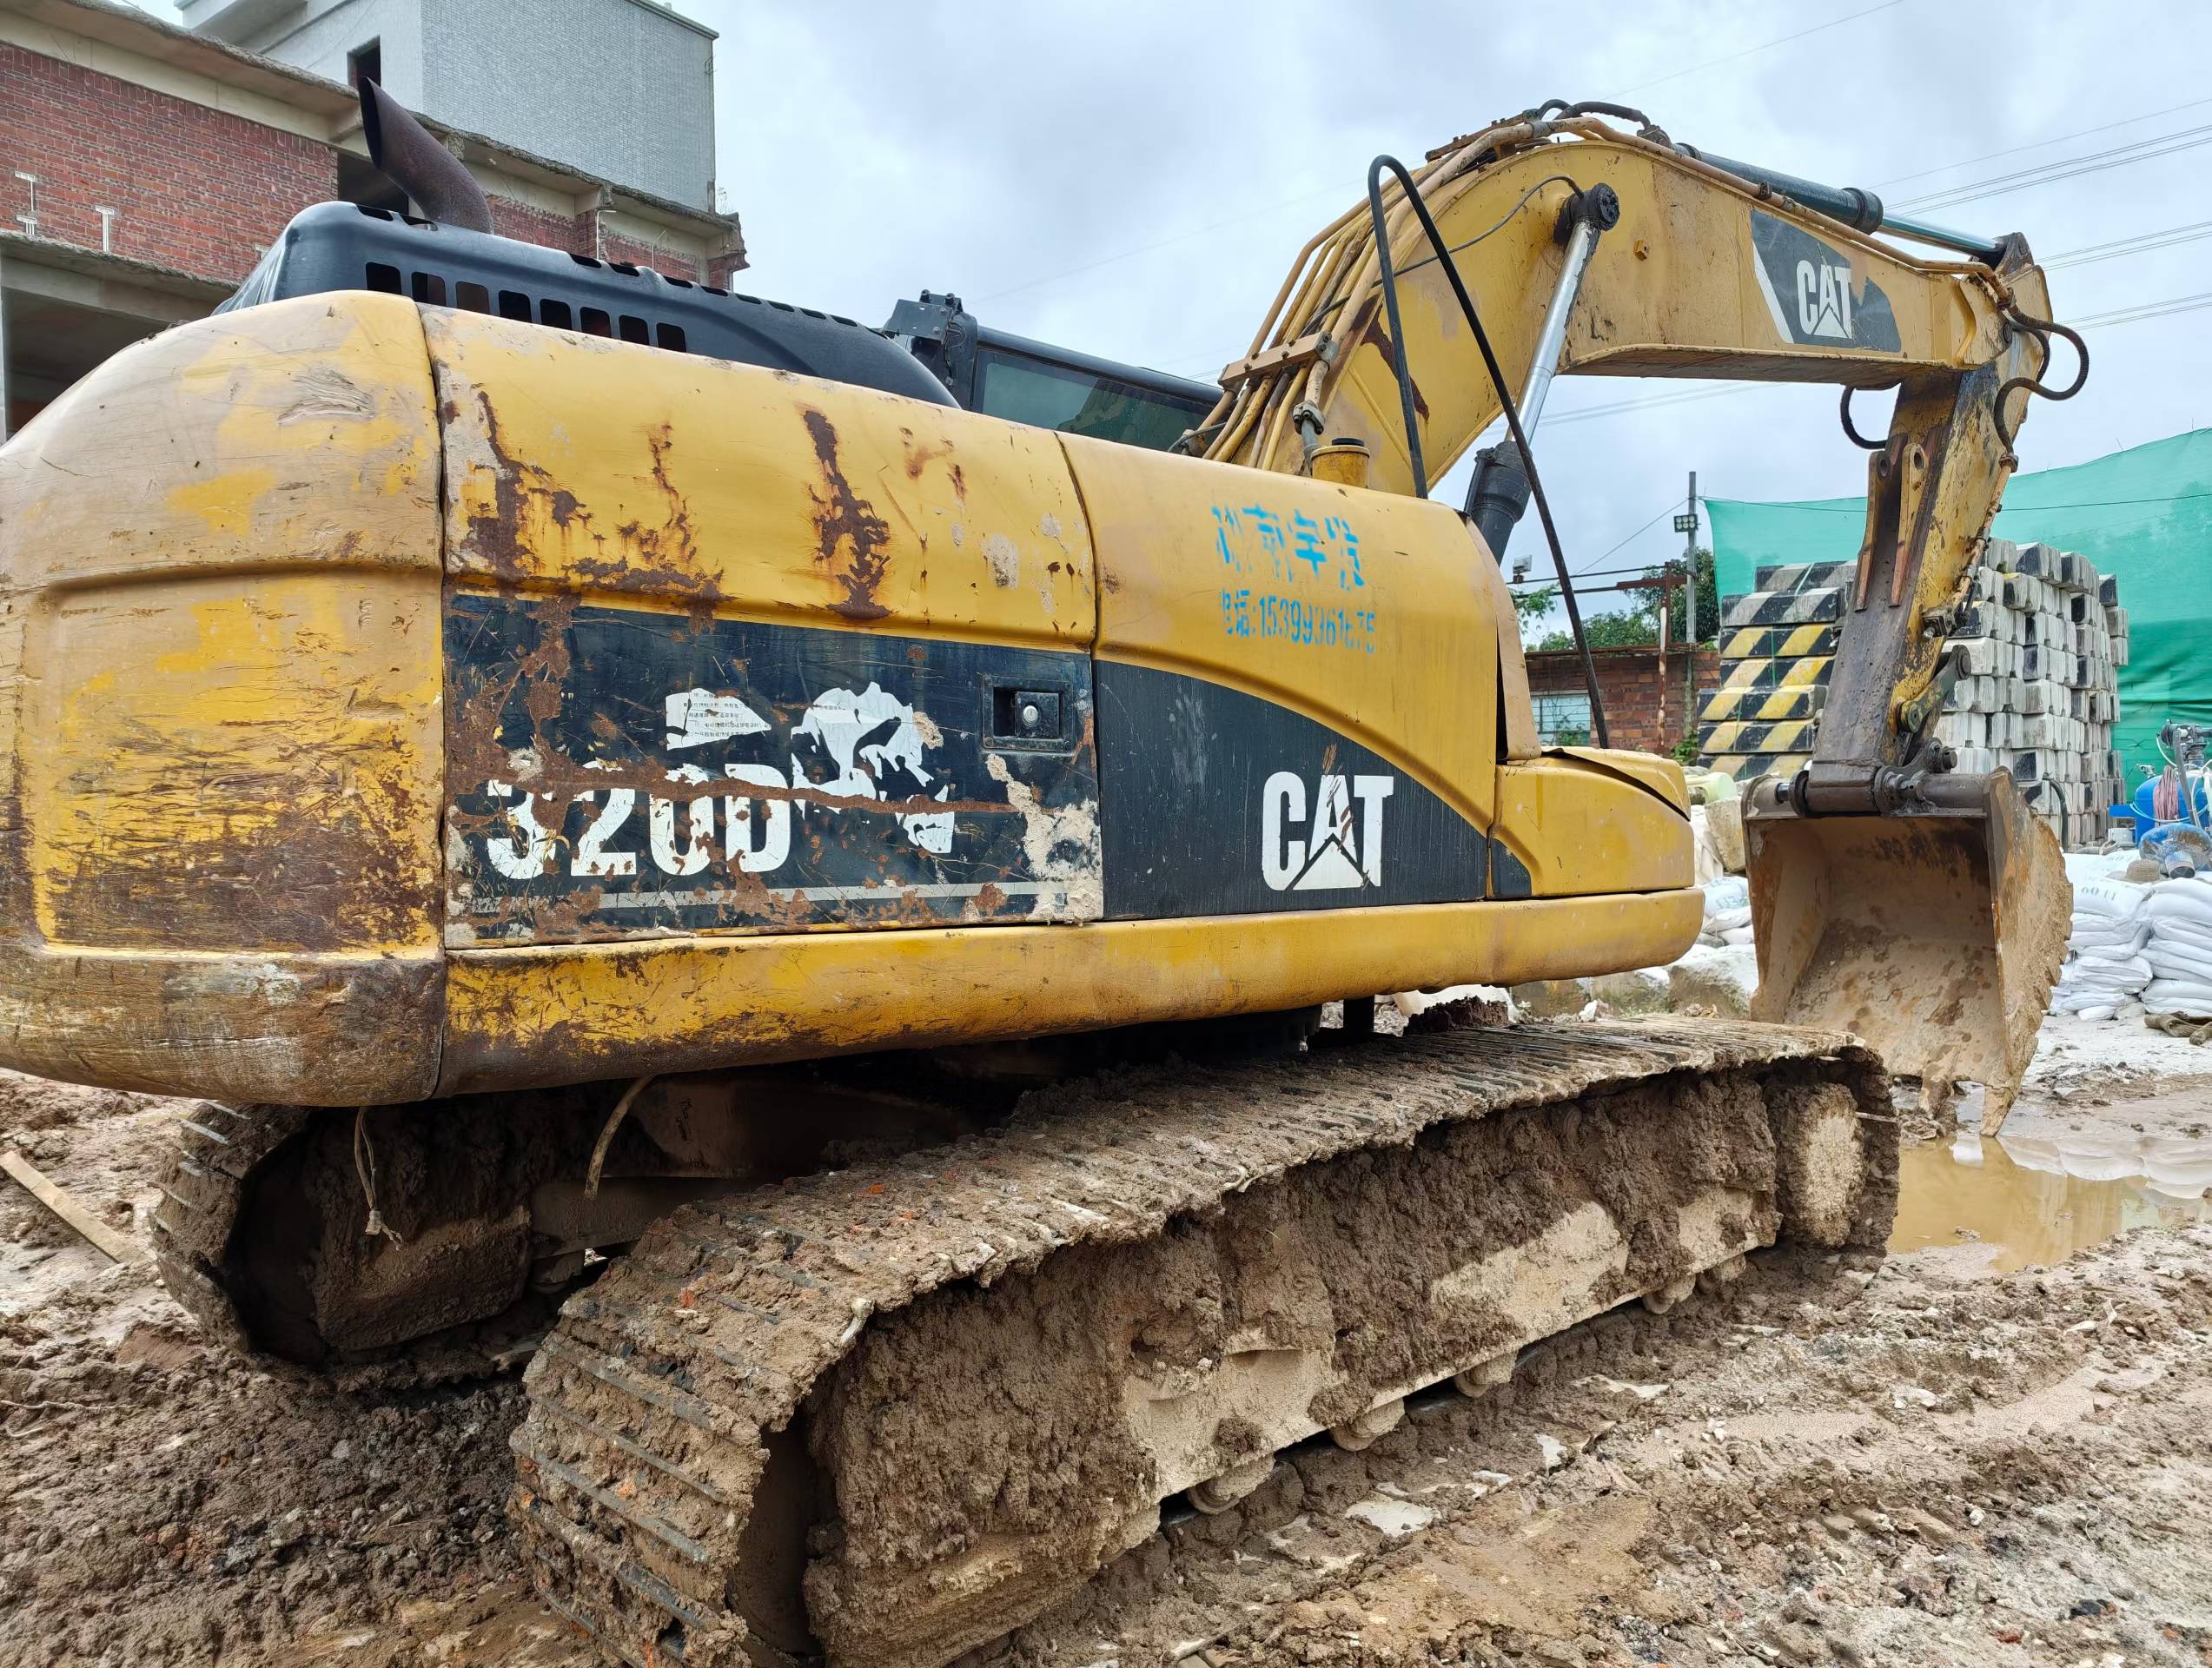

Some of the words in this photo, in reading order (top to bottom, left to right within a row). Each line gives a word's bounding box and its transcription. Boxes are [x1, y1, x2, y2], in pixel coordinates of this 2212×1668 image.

[1797, 260, 1853, 340] CAT
[487, 761, 791, 879] 320D
[1262, 771, 1394, 891] CAT
